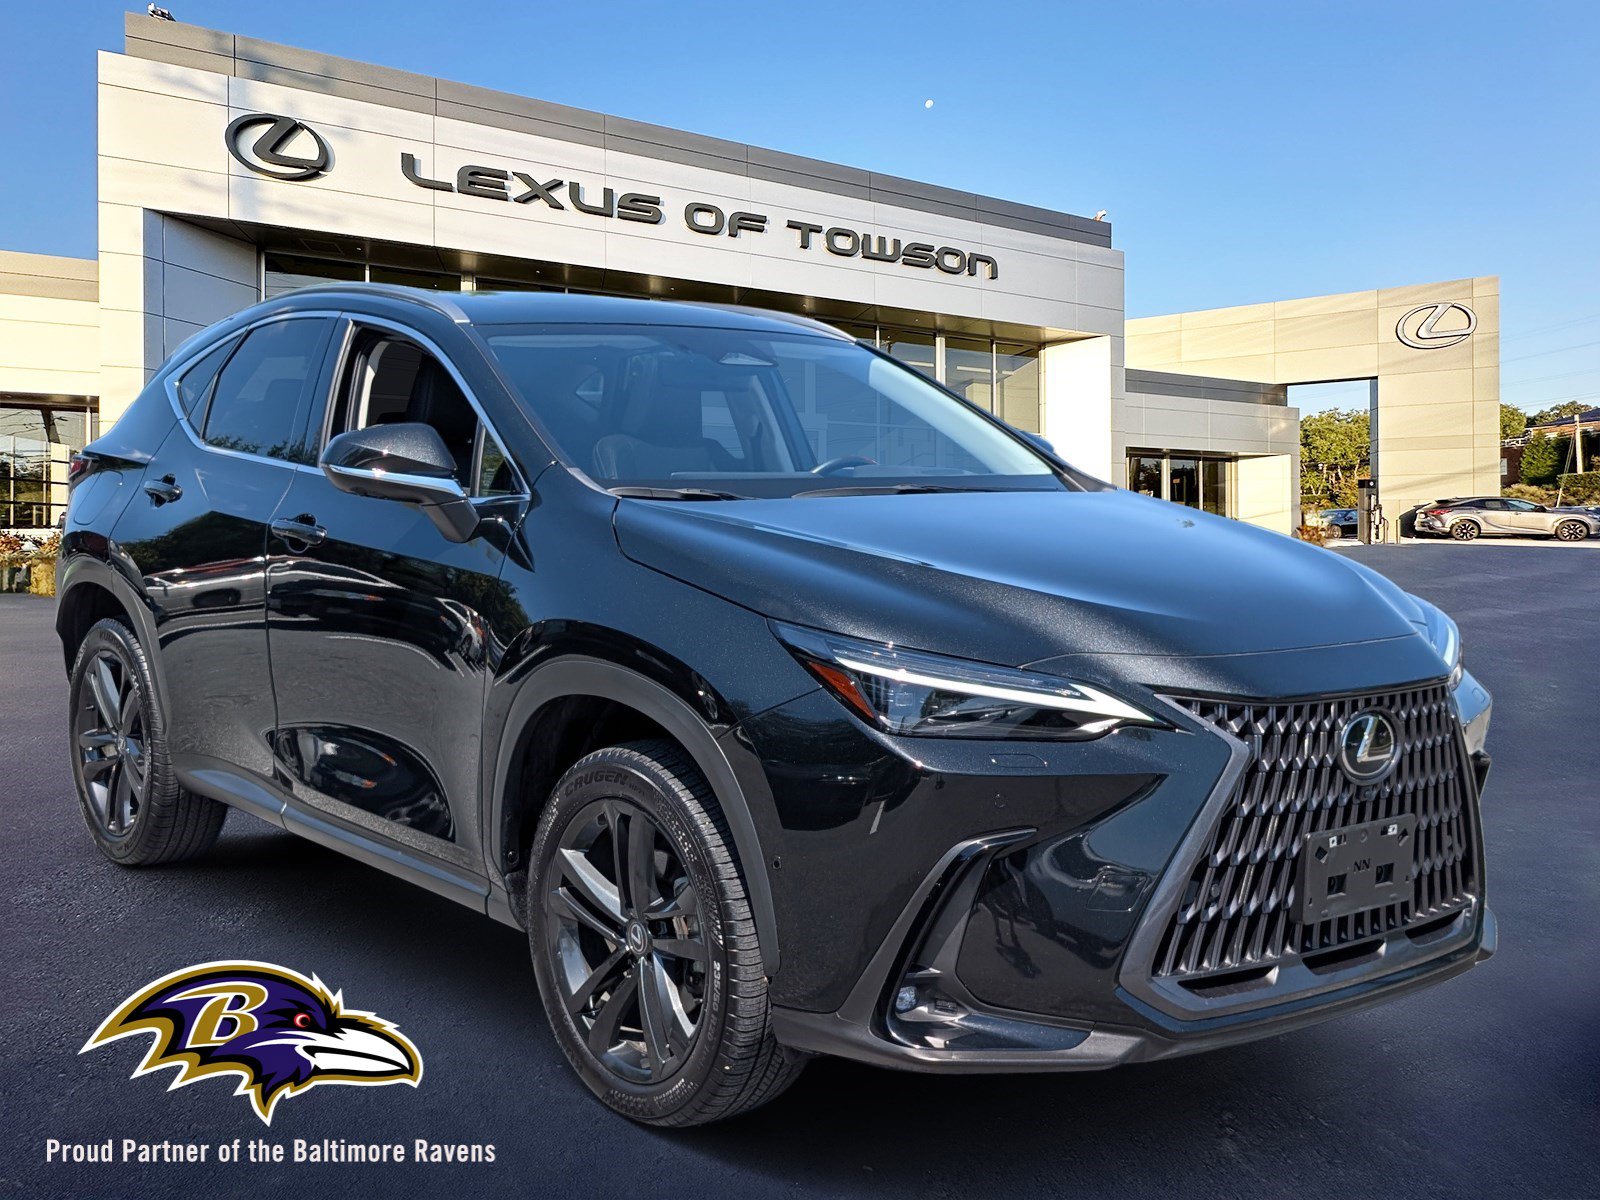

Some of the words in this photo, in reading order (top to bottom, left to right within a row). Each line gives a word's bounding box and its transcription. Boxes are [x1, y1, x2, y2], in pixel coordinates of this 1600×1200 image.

[401, 153, 663, 225] LEXUS
[685, 203, 767, 238] OF
[785, 220, 999, 281] TOWSON
